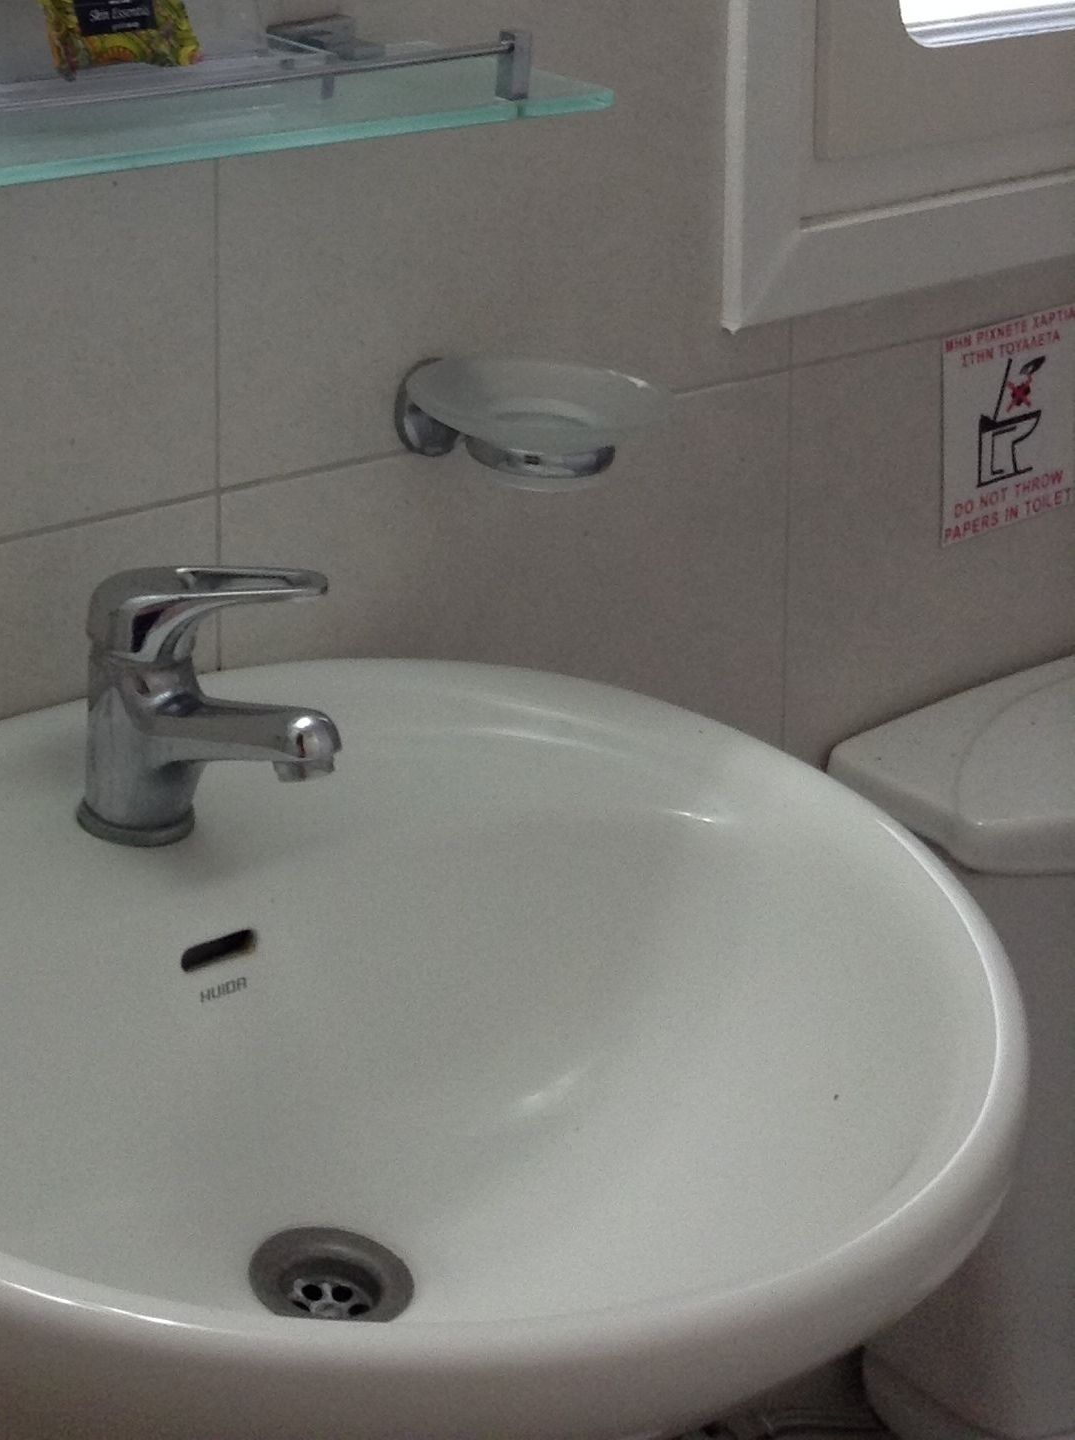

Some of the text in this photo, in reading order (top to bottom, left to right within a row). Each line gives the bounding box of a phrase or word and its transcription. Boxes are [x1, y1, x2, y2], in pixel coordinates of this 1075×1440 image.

[945, 334, 972, 352] ΜΗΝ
[976, 320, 1027, 344] ΡΙΧΝΕΤΕ
[962, 329, 1061, 368] ΣΤΗΝ ΤΟΥΑΛΕΤΑ
[954, 469, 1064, 518] DO NOT THROW
[944, 487, 1072, 542] PAPERS IN TOILET
[200, 976, 248, 1003] HUIDA
